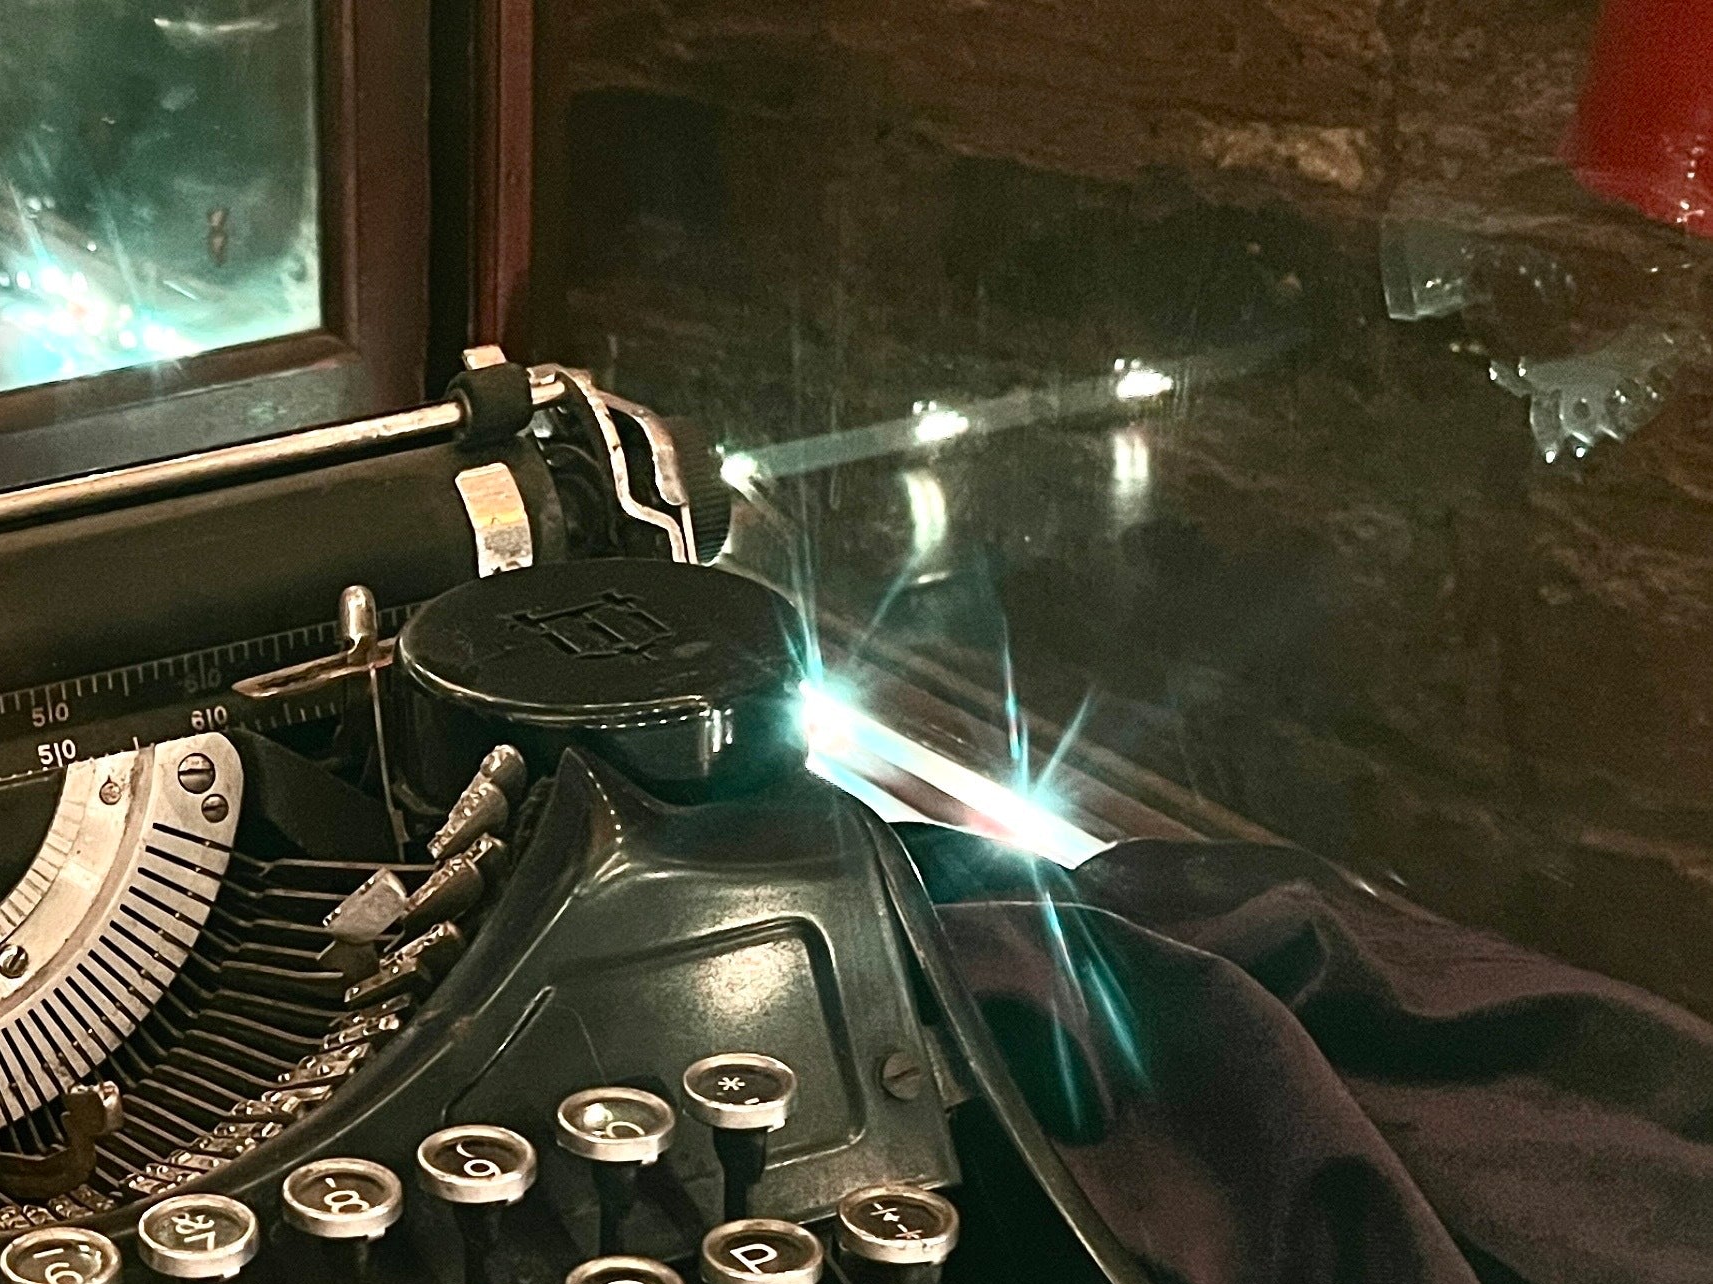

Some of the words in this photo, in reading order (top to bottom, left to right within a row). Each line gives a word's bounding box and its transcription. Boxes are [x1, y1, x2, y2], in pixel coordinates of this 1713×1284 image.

[464, 1158, 500, 1178] 9
[323, 1190, 370, 1213] 8
[171, 1213, 215, 1235] &
[183, 1231, 217, 1251] 7
[729, 1243, 778, 1274] P
